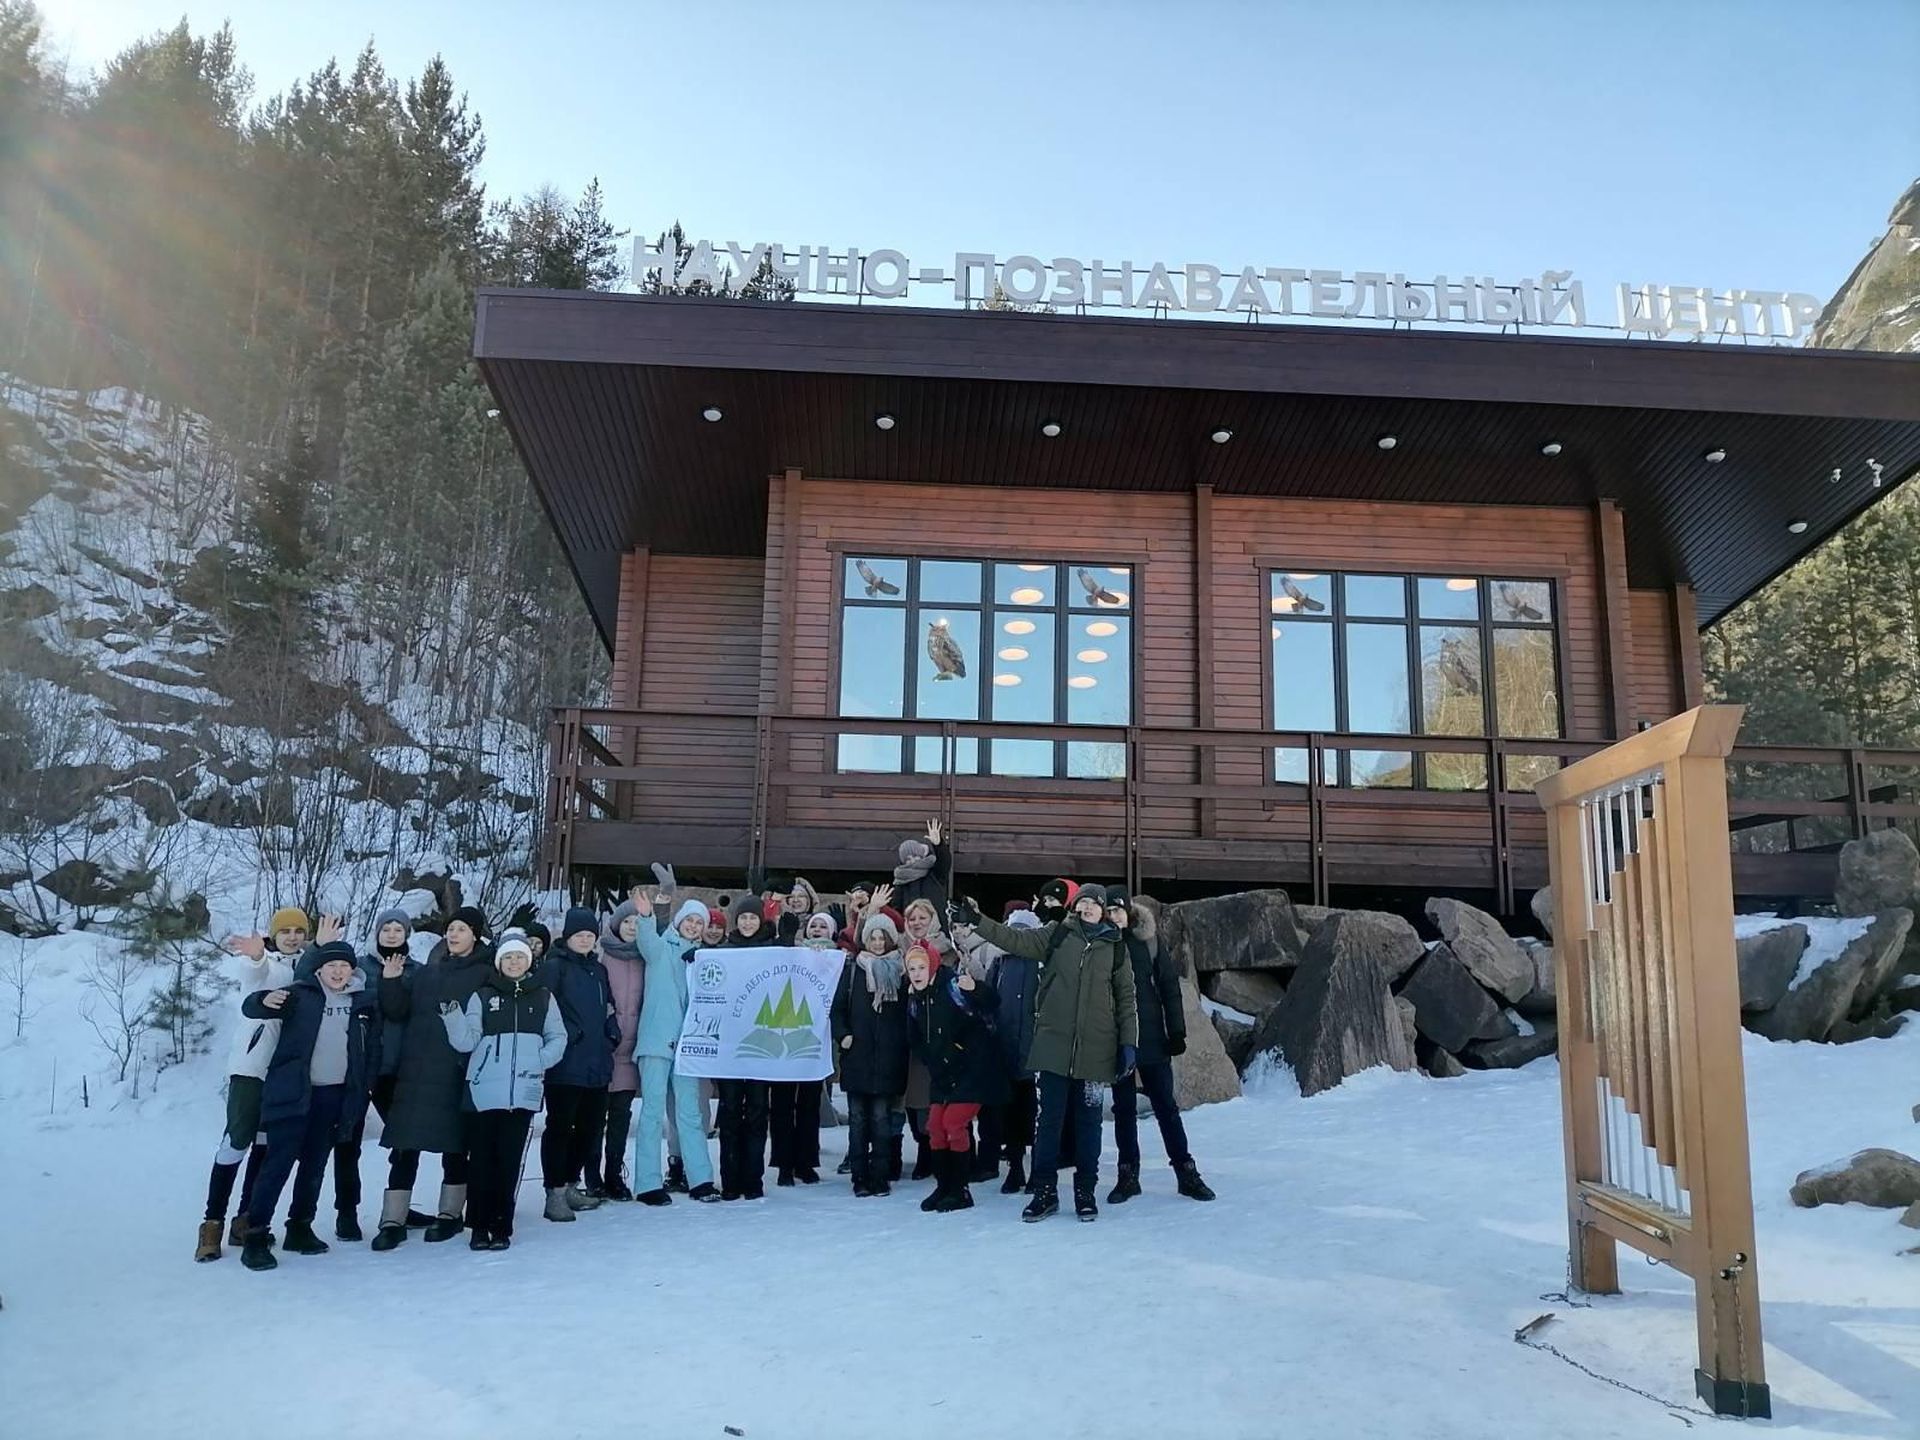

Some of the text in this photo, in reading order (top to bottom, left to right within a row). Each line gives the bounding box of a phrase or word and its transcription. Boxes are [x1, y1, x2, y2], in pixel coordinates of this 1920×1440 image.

[632, 235, 1823, 340] НАУЧНО-ПОЗНАВАТЕЛЬНЫЙ ЦЕНТР
[732, 993, 748, 1018] ЕСТЬ
[746, 970, 770, 993] ДЕЛО
[773, 964, 788, 976] ДО
[790, 963, 826, 992] ЛЕСНОГО
[681, 1045, 719, 1055] СТОЛБЫ
